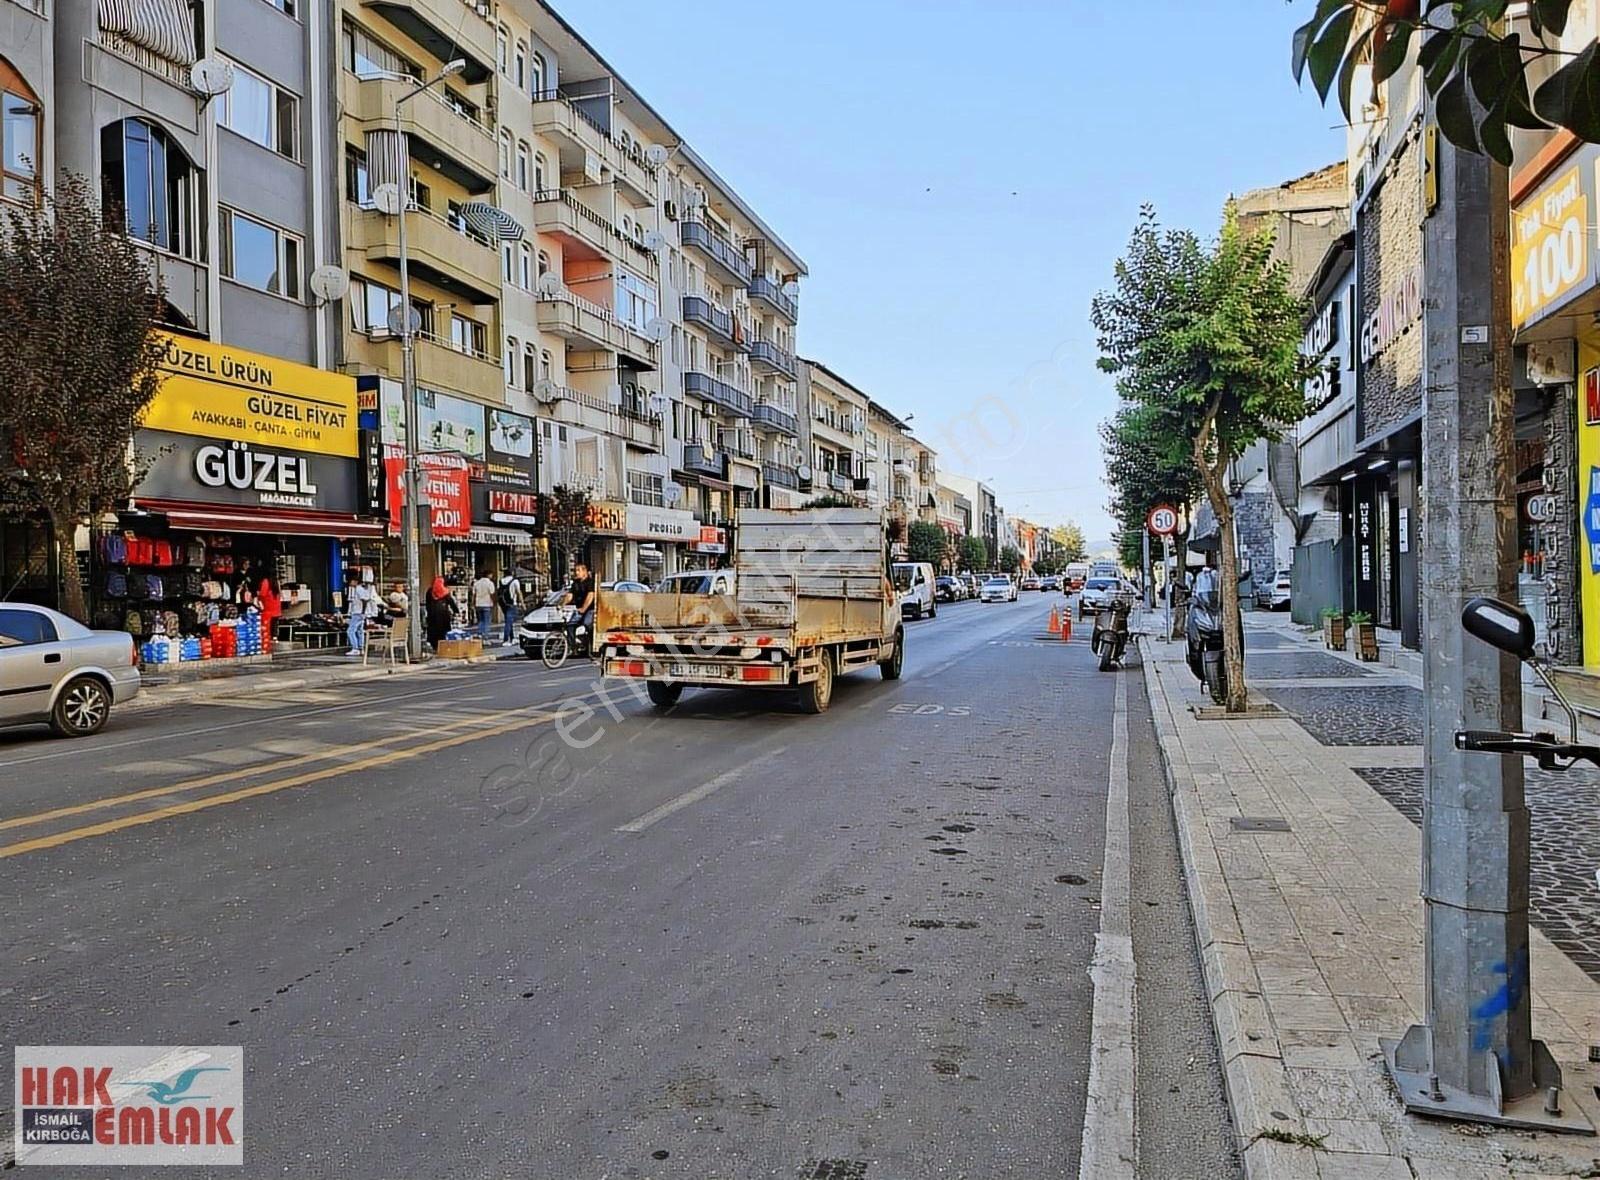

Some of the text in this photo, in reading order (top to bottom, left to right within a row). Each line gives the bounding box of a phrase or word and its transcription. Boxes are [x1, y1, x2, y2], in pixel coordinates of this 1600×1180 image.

[220, 355, 272, 386] ÜRÜN
[192, 410, 321, 440] AYAKKABI ÇANTA GİYİM
[247, 395, 347, 428] GÜZEL FİYAT
[195, 441, 317, 494] GÜZEL
[1155, 512, 1173, 528] 50
[887, 703, 971, 716] EDS
